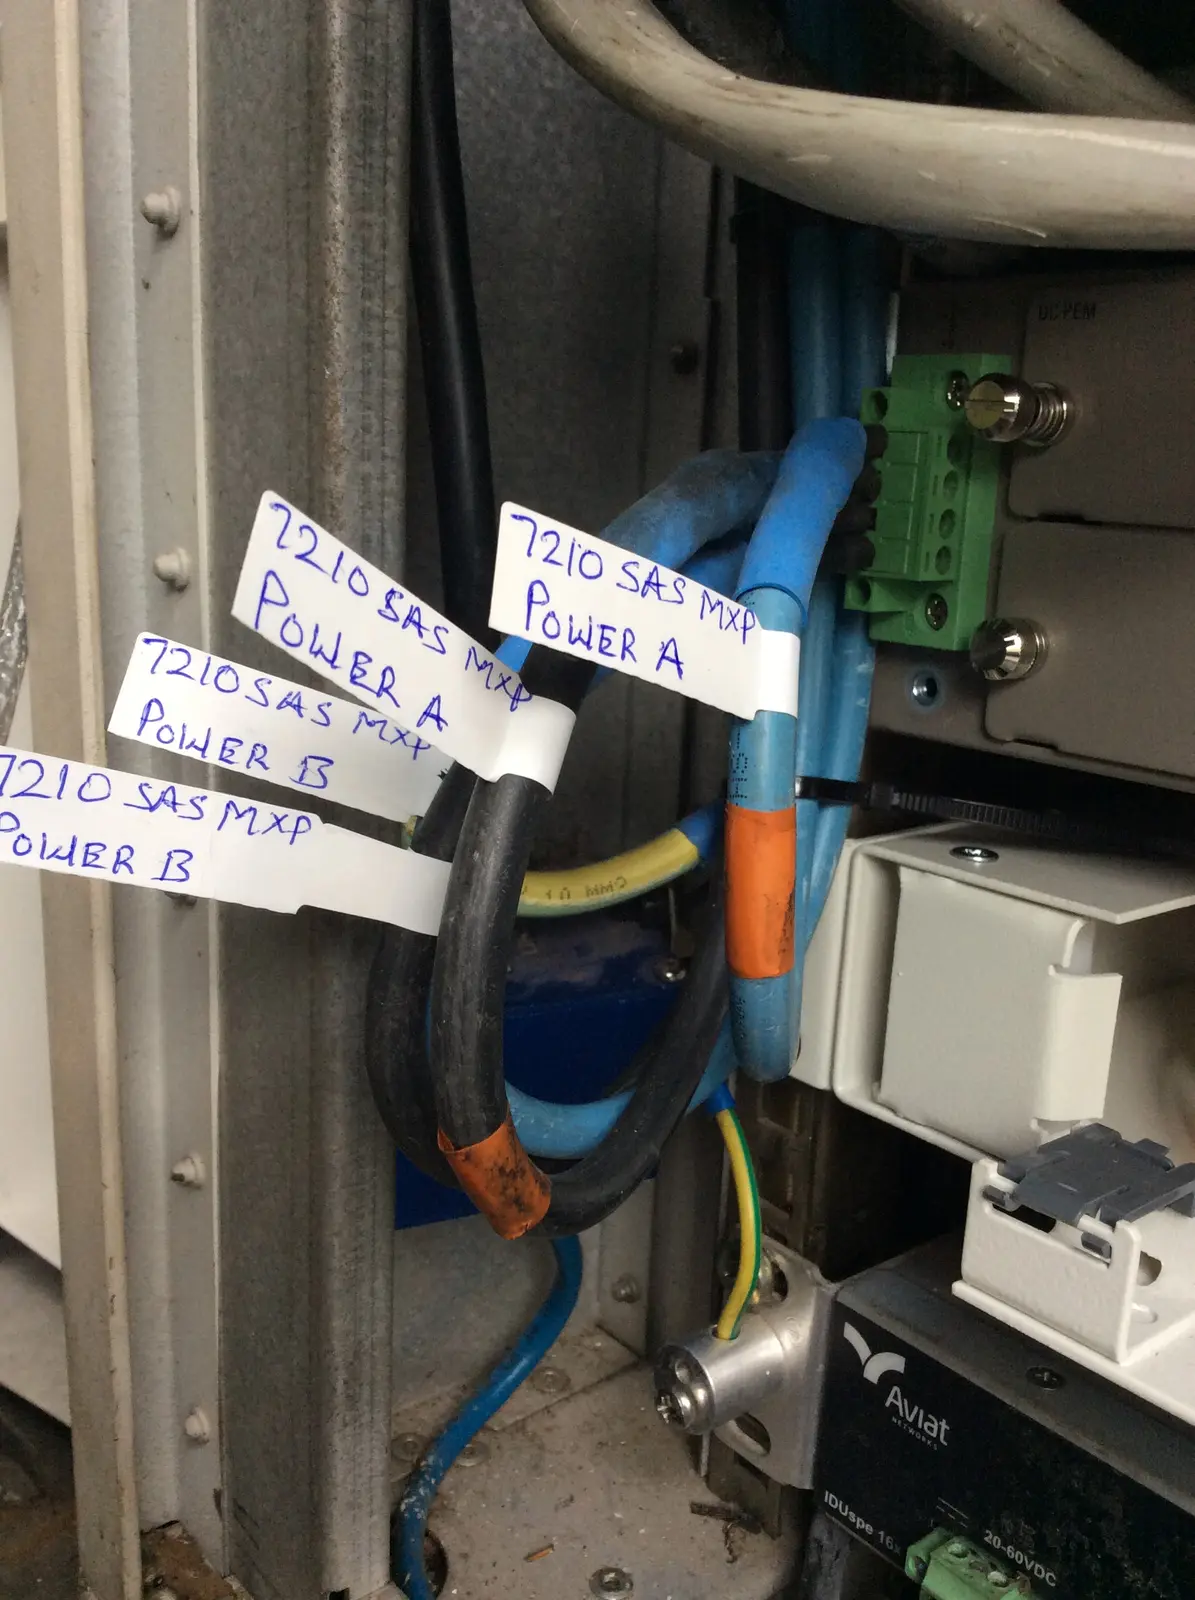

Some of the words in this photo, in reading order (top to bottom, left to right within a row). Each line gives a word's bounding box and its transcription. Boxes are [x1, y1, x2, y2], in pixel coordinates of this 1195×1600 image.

[269, 501, 370, 597] 7210
[377, 587, 450, 655] SAS
[464, 645, 533, 712] MXP
[510, 512, 603, 580] 7210
[616, 561, 687, 605] SAS
[699, 589, 757, 645] MXP
[254, 569, 401, 708] POWER
[416, 694, 449, 733] A
[524, 579, 638, 664] POWER
[655, 636, 685, 681] A
[143, 636, 240, 695] 7210
[244, 677, 332, 729] SAS
[137, 697, 270, 772] POWER
[288, 754, 335, 790] B
[0, 753, 112, 804] 7210
[123, 781, 209, 820] SAS
[217, 800, 312, 845] MXP
[151, 847, 194, 883] B
[891, 1415, 938, 1451] NETWORKS
[823, 1489, 875, 1536] IDUspe
[983, 1528, 1058, 1588] 20-60VDC
